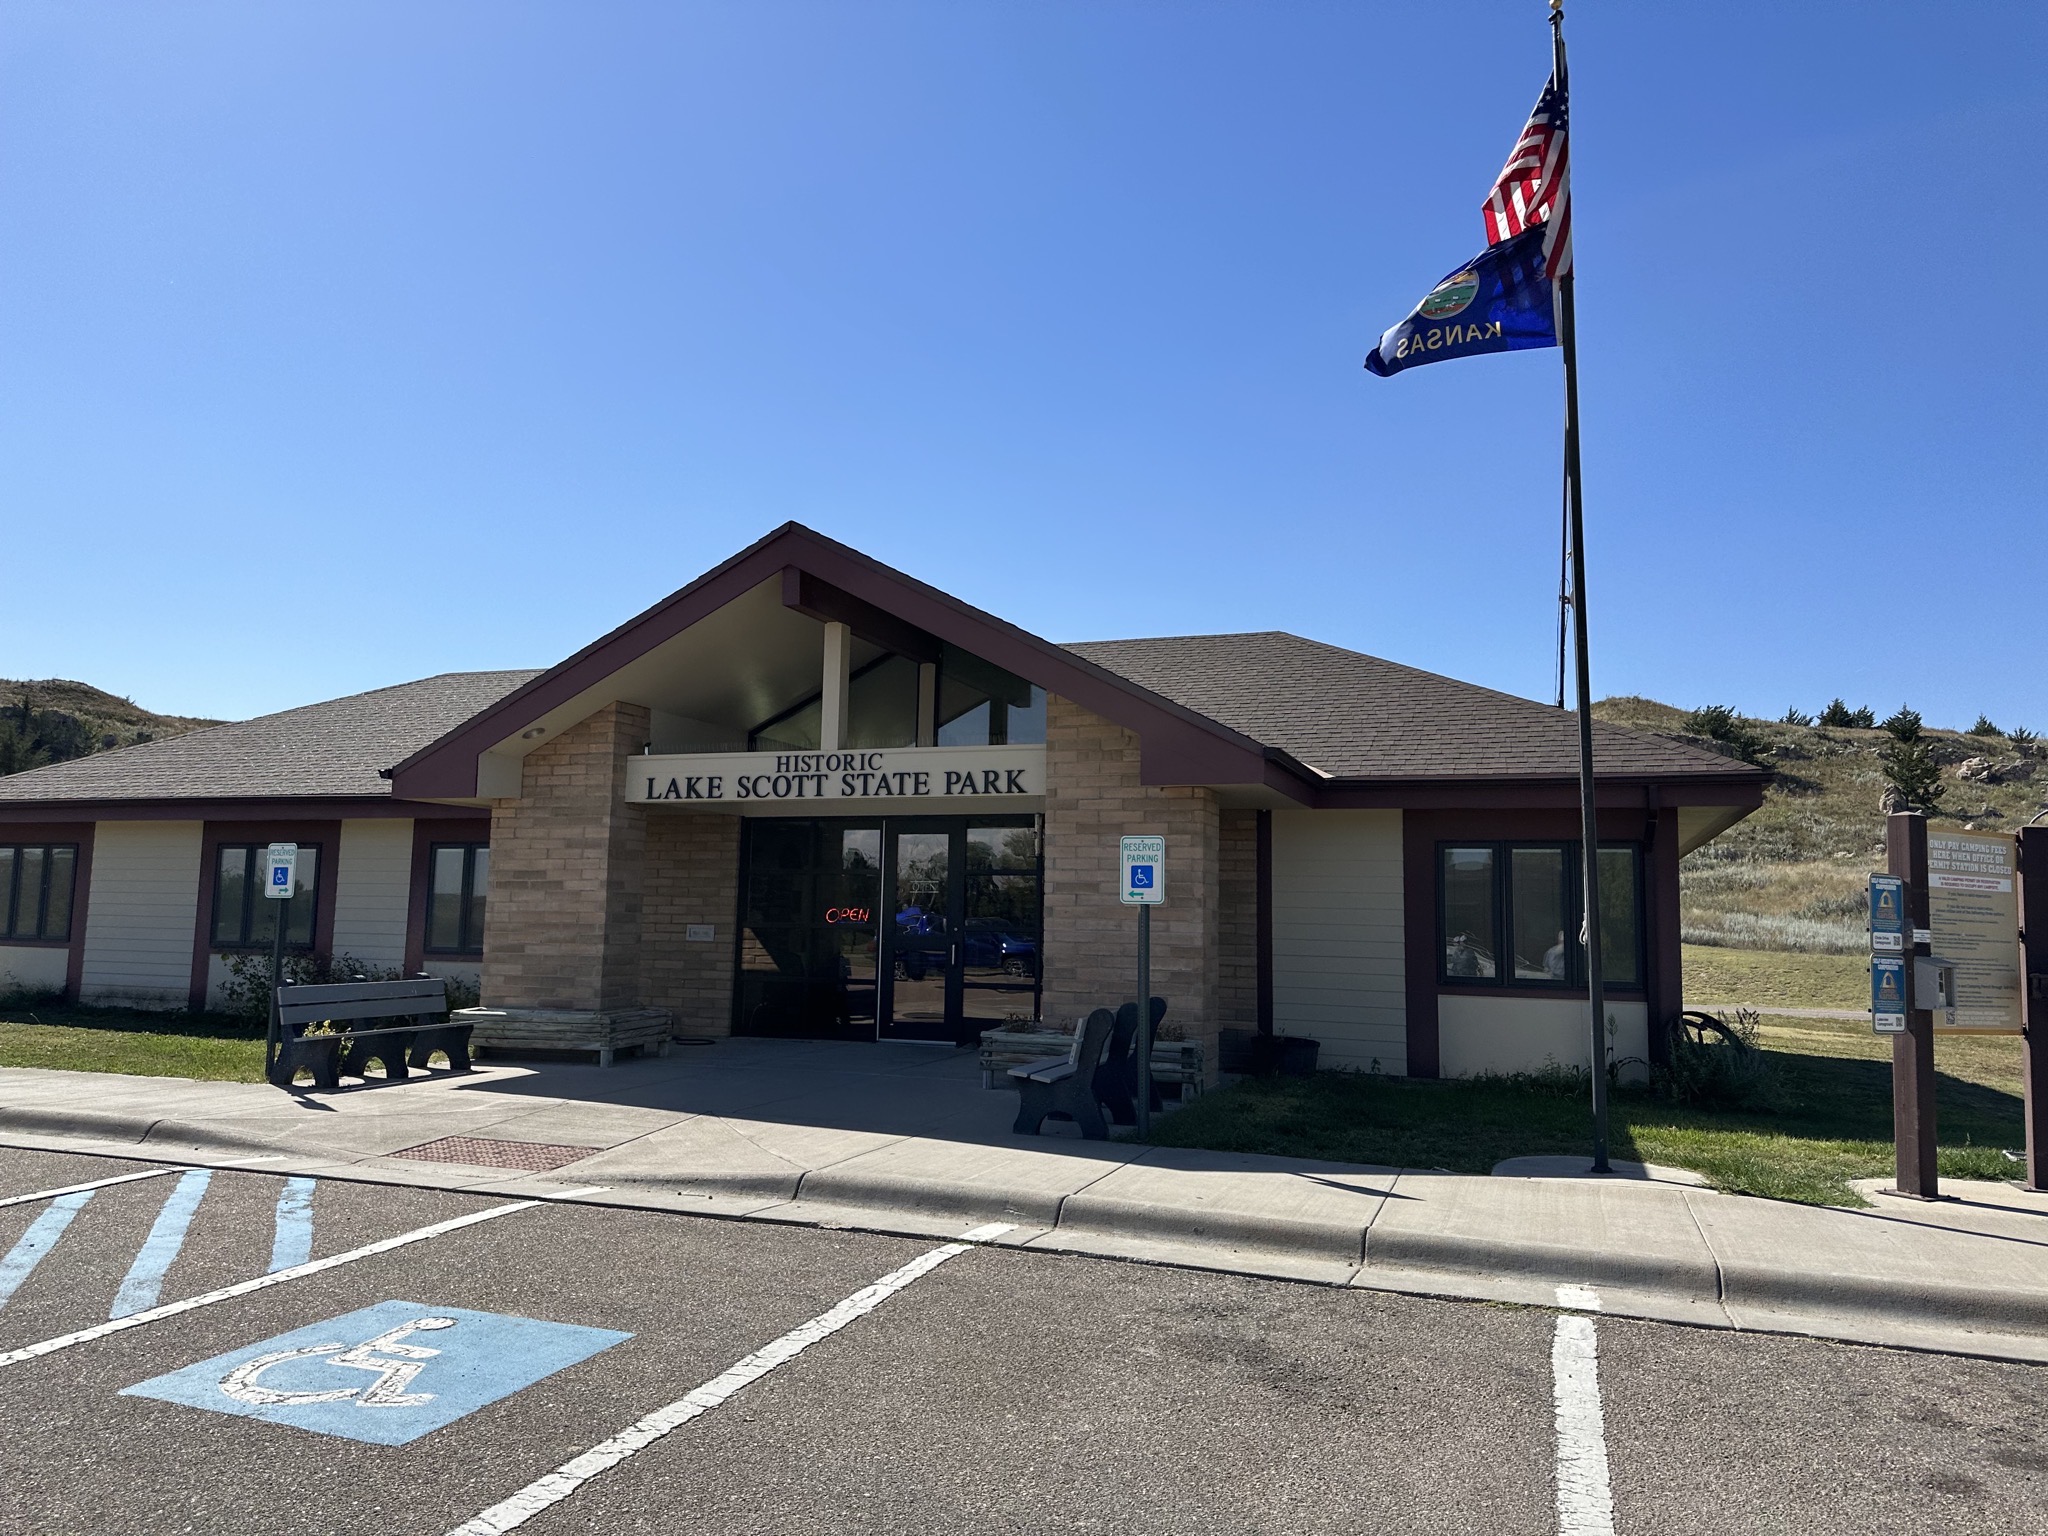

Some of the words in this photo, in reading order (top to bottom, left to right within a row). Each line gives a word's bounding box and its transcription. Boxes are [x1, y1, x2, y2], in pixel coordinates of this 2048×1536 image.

[776, 752, 883, 773] HISTORIC
[646, 776, 723, 800] LAKE
[736, 774, 828, 799] SCOTT
[842, 772, 930, 796] STATE
[944, 770, 1028, 794] PARK
[1124, 842, 1161, 852] RESERVED
[1930, 840, 1946, 849] ONLY
[1948, 842, 1960, 850] PAY
[1961, 842, 1990, 853] CAMPING
[1991, 846, 2007, 854] FEES
[1127, 854, 1158, 863] PARKING
[1933, 850, 1950, 860] HERE
[1952, 852, 1971, 861] WHEN
[1972, 854, 1994, 863] OFFICE
[1996, 856, 2004, 864] OR
[1952, 862, 1979, 872] STATION
[1980, 864, 1987, 872] IS
[1989, 865, 2012, 875] CLOSED
[826, 908, 870, 923] OPEN
